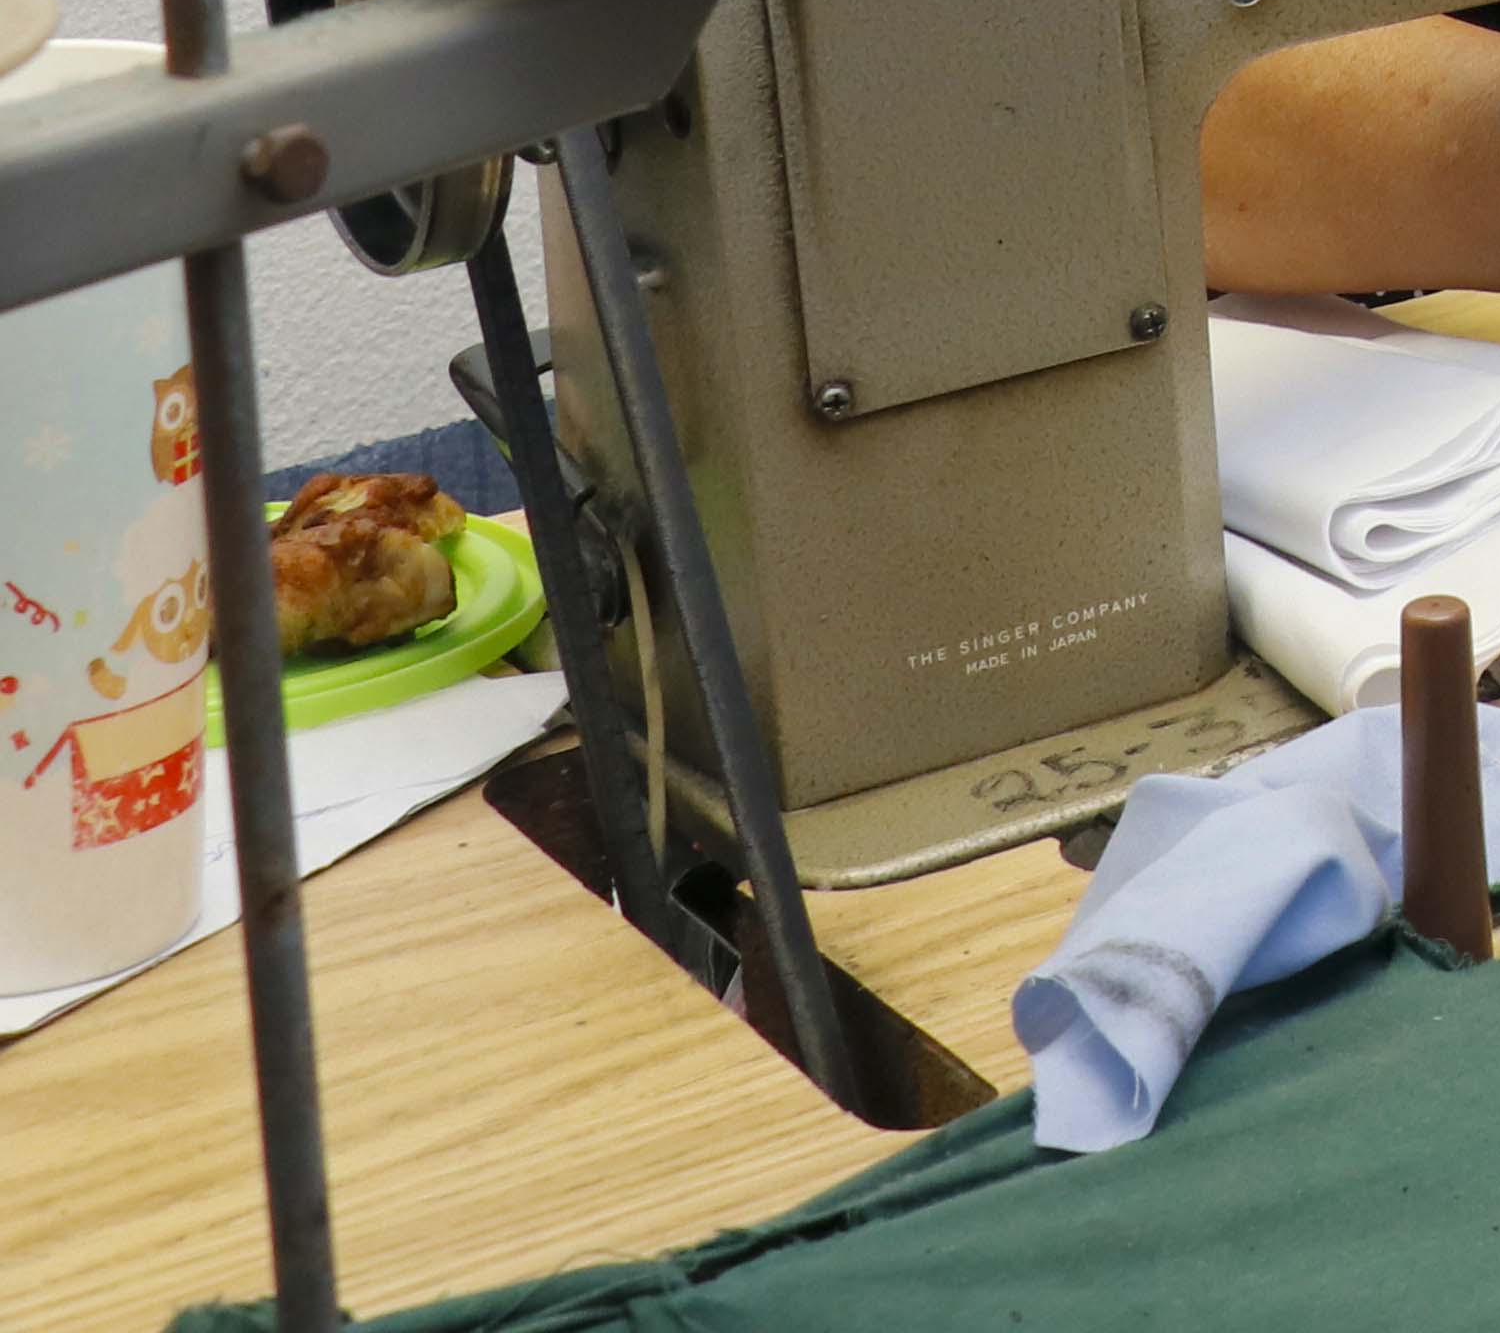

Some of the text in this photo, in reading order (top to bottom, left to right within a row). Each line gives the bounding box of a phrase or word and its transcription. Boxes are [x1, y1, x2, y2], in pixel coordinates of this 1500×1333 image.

[907, 592, 1150, 670] THE SINGER COMPANY
[965, 629, 1098, 676] MADE IN JAPAN
